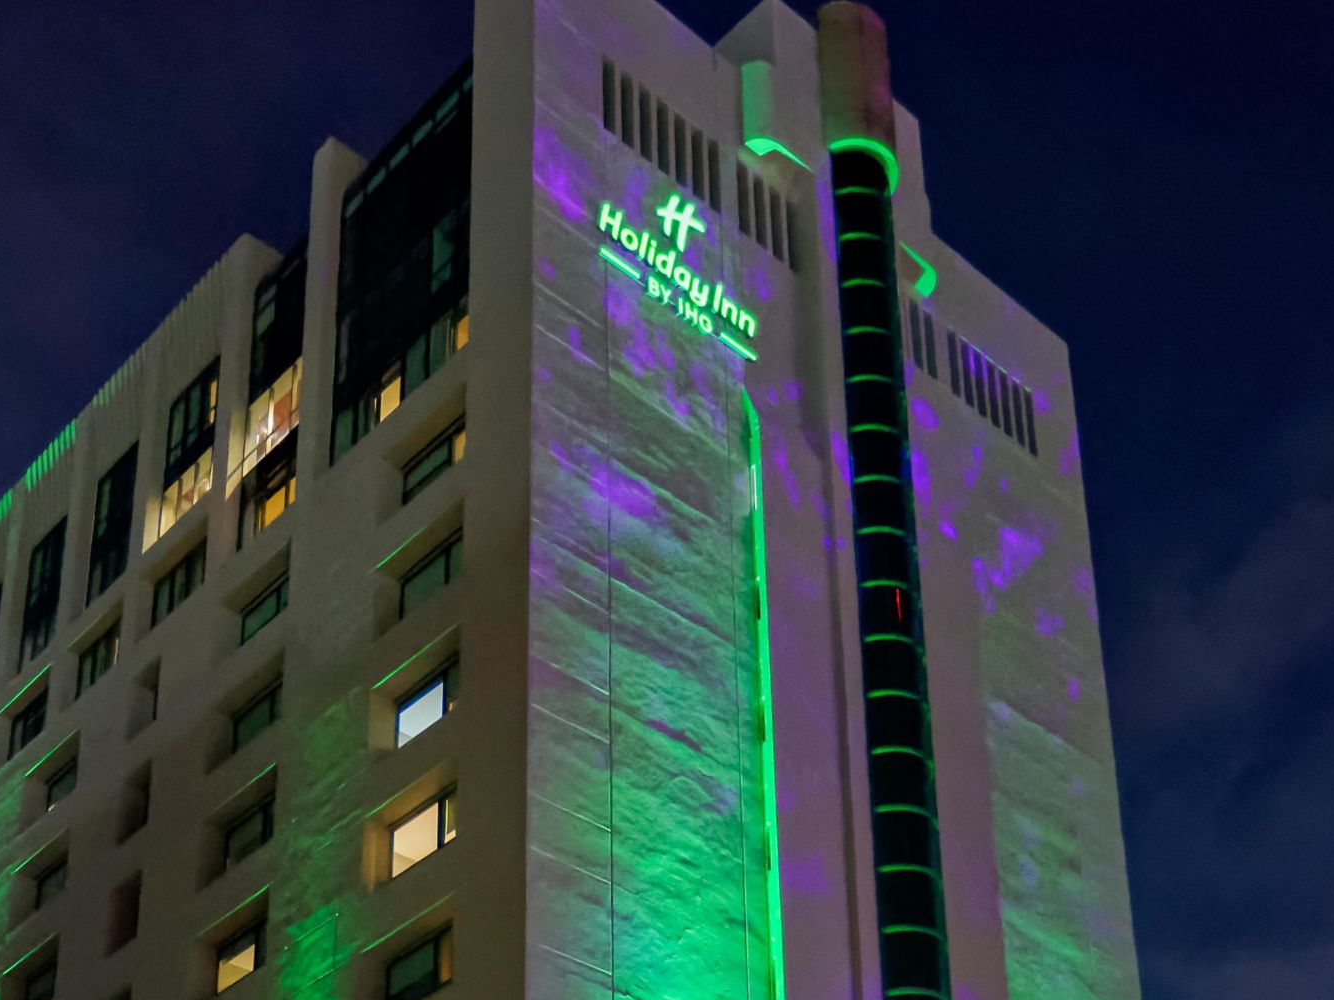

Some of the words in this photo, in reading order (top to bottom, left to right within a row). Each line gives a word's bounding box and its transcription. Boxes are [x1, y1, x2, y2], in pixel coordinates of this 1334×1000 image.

[598, 202, 710, 308] Holiday
[712, 281, 757, 338] Inn
[646, 275, 671, 304] BY
[676, 297, 713, 334] IHG
